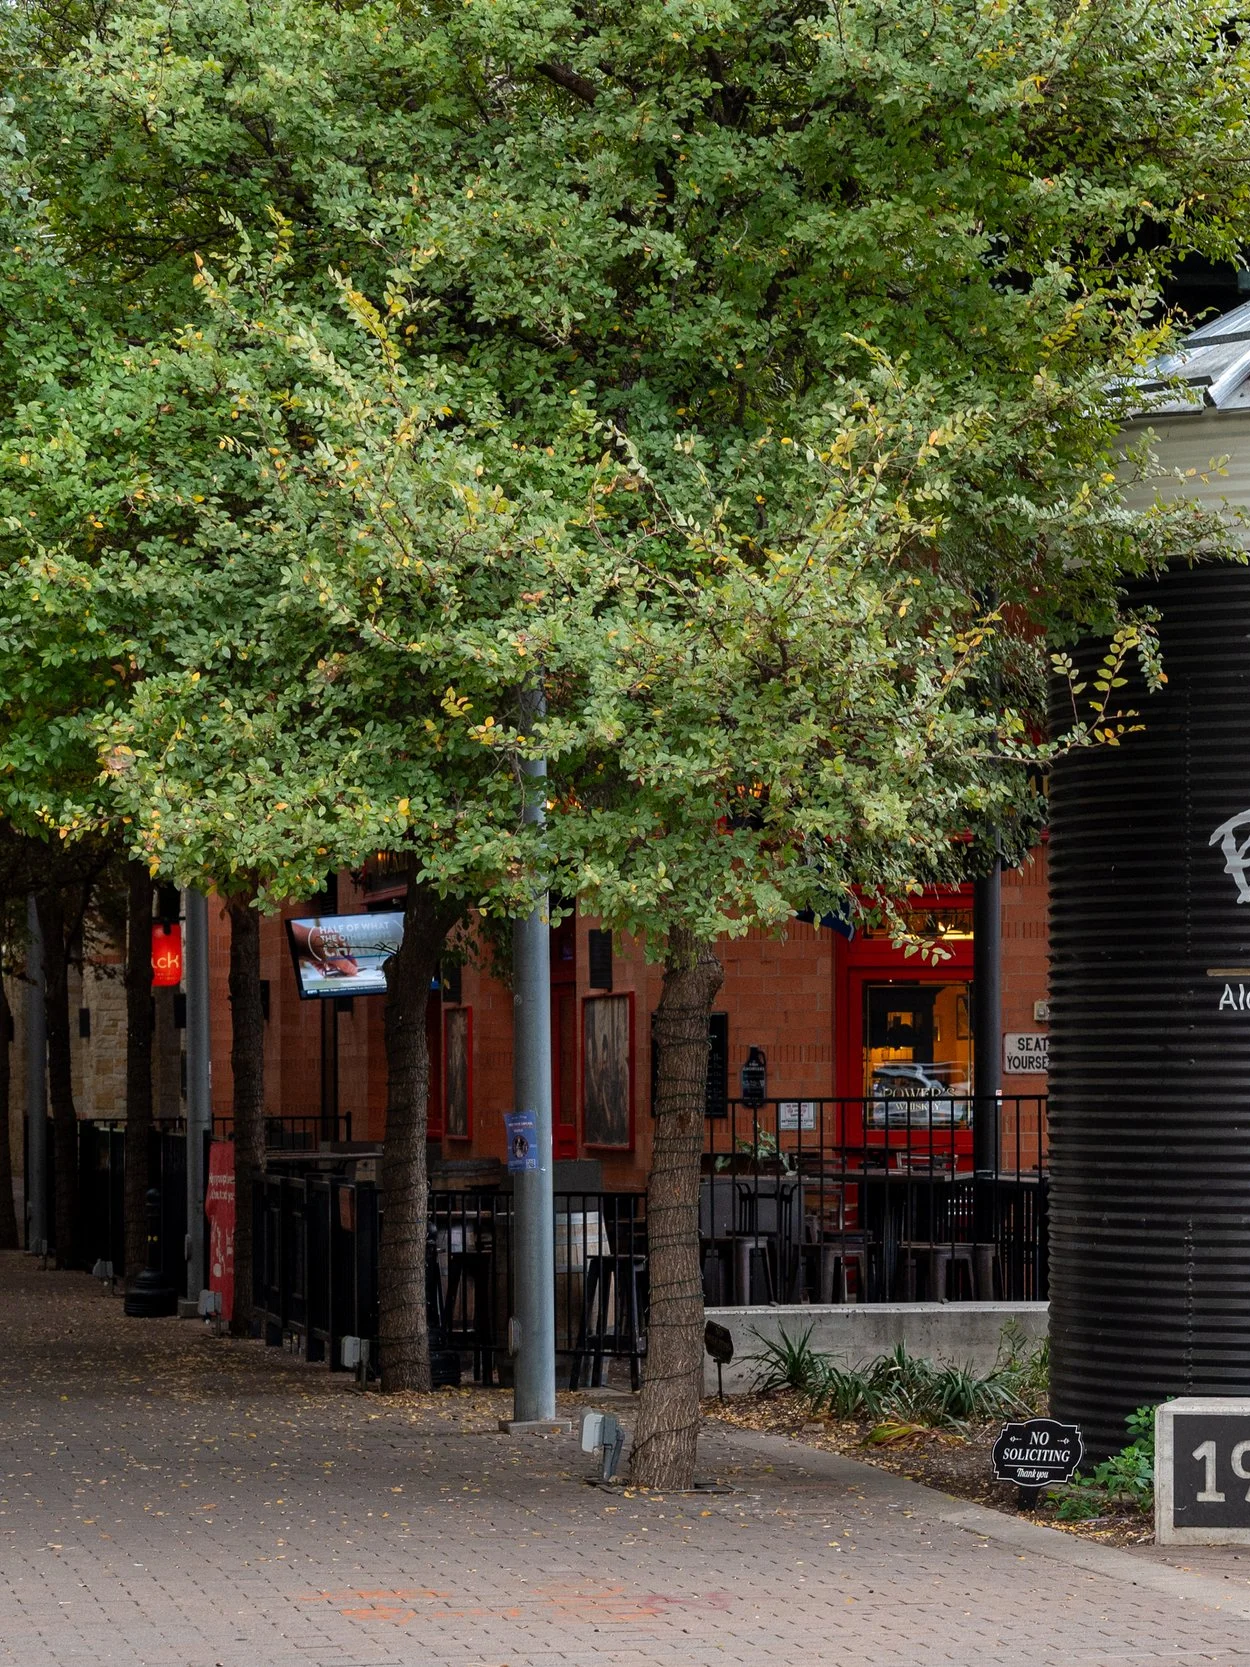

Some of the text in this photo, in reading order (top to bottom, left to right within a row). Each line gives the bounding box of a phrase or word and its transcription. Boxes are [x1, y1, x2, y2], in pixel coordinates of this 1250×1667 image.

[346, 924, 360, 932] OF
[361, 921, 389, 931] WHAT
[1017, 1037, 1048, 1052] SEAT
[895, 1102, 941, 1111] WHISKY
[1029, 1431, 1050, 1446] NO
[1002, 1447, 1071, 1463] SOLICITING
[1016, 1467, 1049, 1481] Thank you
